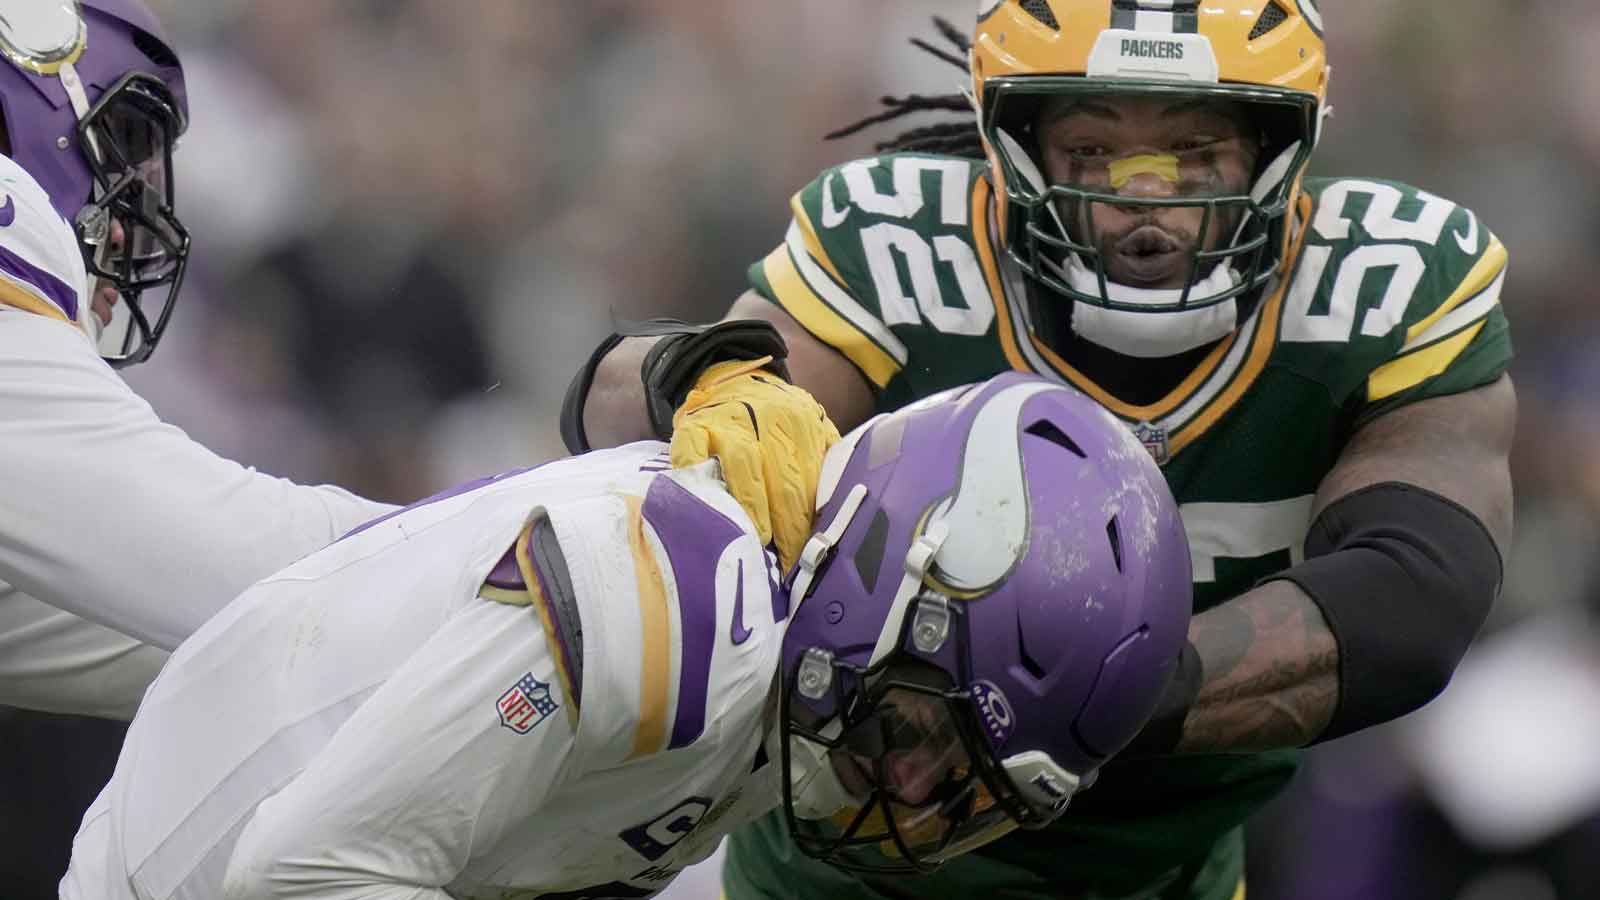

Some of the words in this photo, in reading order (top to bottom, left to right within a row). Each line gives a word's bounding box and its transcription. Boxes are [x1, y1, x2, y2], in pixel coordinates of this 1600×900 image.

[1120, 38, 1184, 60] PACKERS
[840, 156, 996, 337] 52
[1279, 179, 1457, 343] 52
[500, 689, 538, 732] NFL
[972, 684, 1005, 738] OAKLEY
